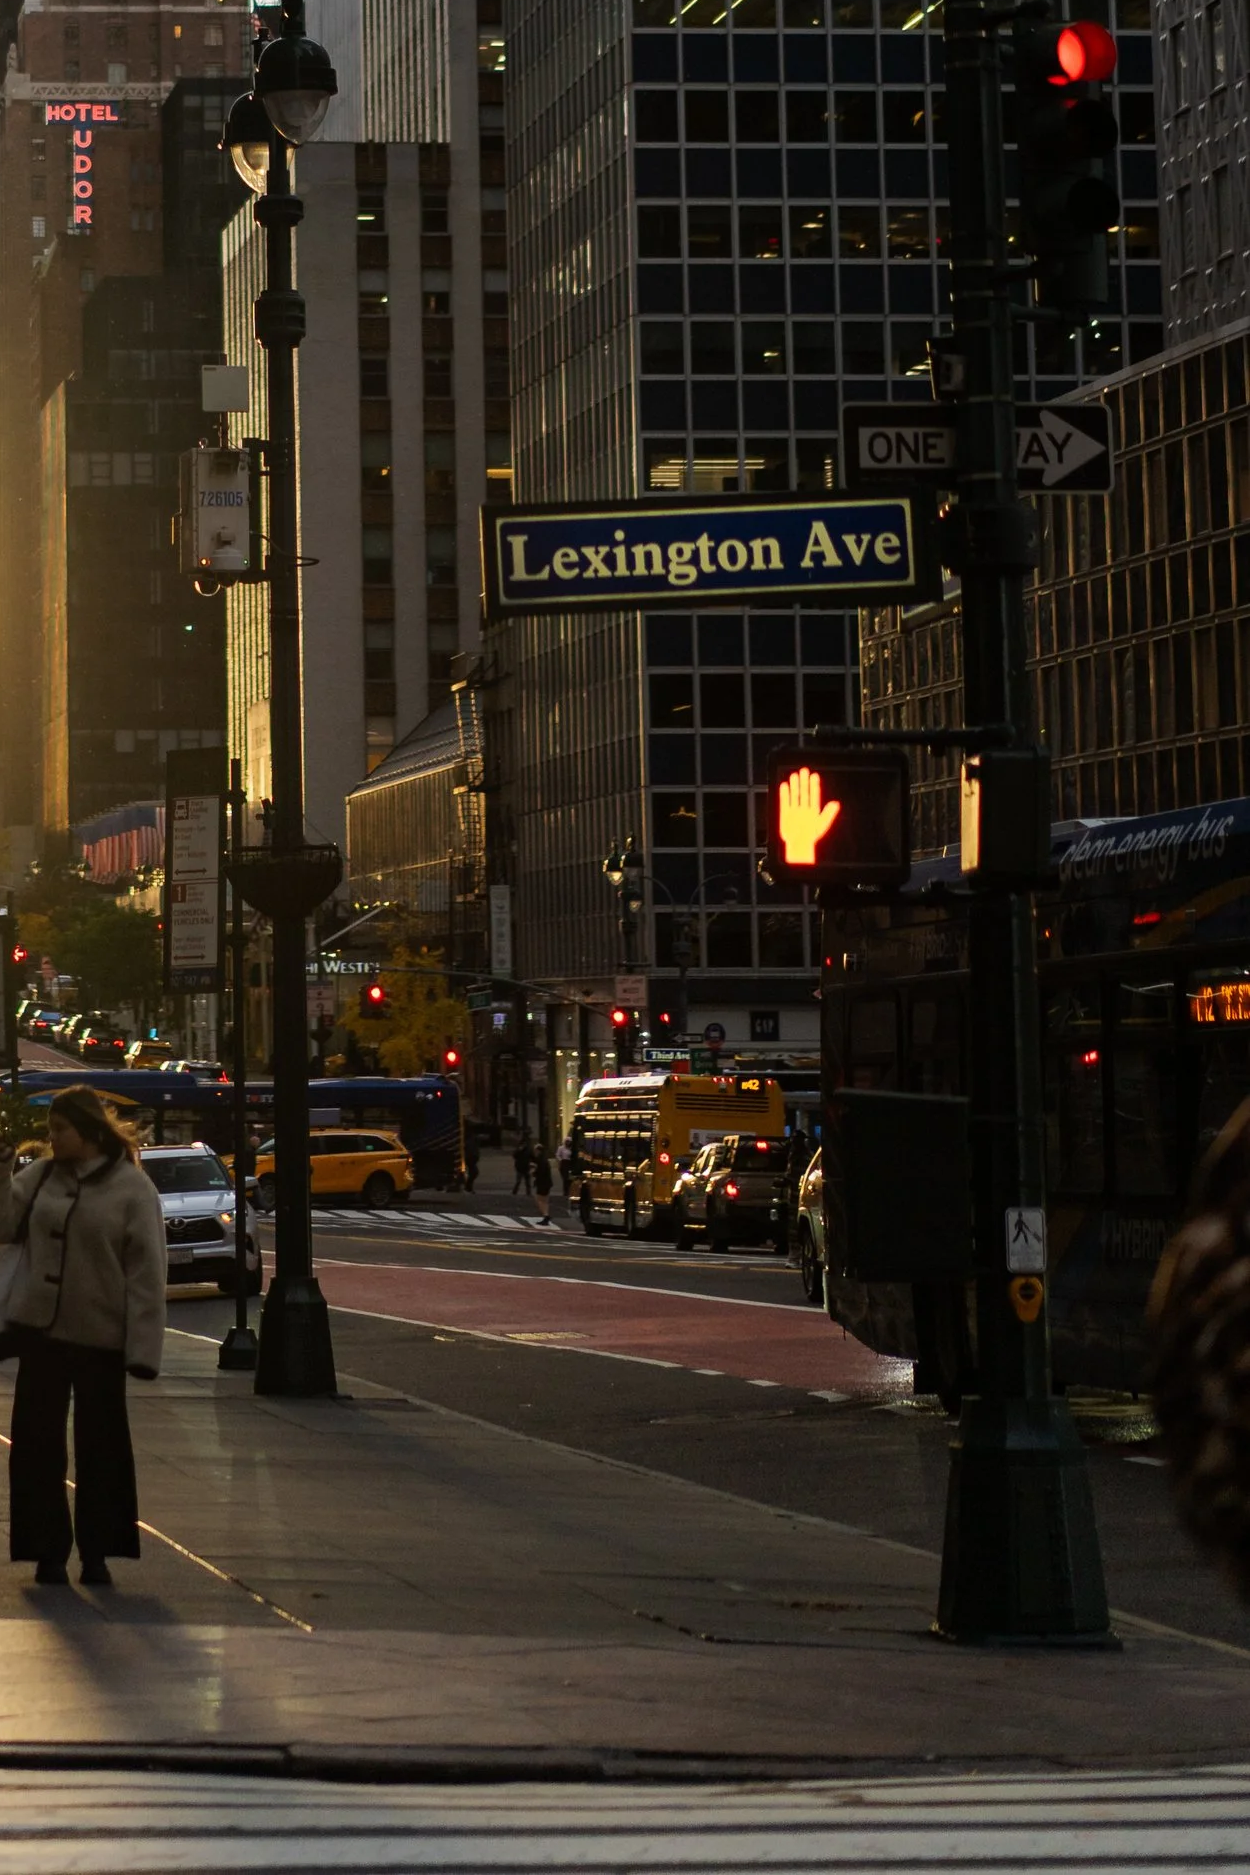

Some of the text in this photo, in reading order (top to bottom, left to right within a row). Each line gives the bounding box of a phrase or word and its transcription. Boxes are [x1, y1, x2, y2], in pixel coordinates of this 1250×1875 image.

[47, 103, 119, 122] HOTEL
[867, 431, 1073, 464] ONE AY
[199, 491, 243, 507] 726105
[507, 520, 902, 586] Lexington Ave
[1187, 807, 1235, 862] bus
[650, 1050, 691, 1060] Third Ave
